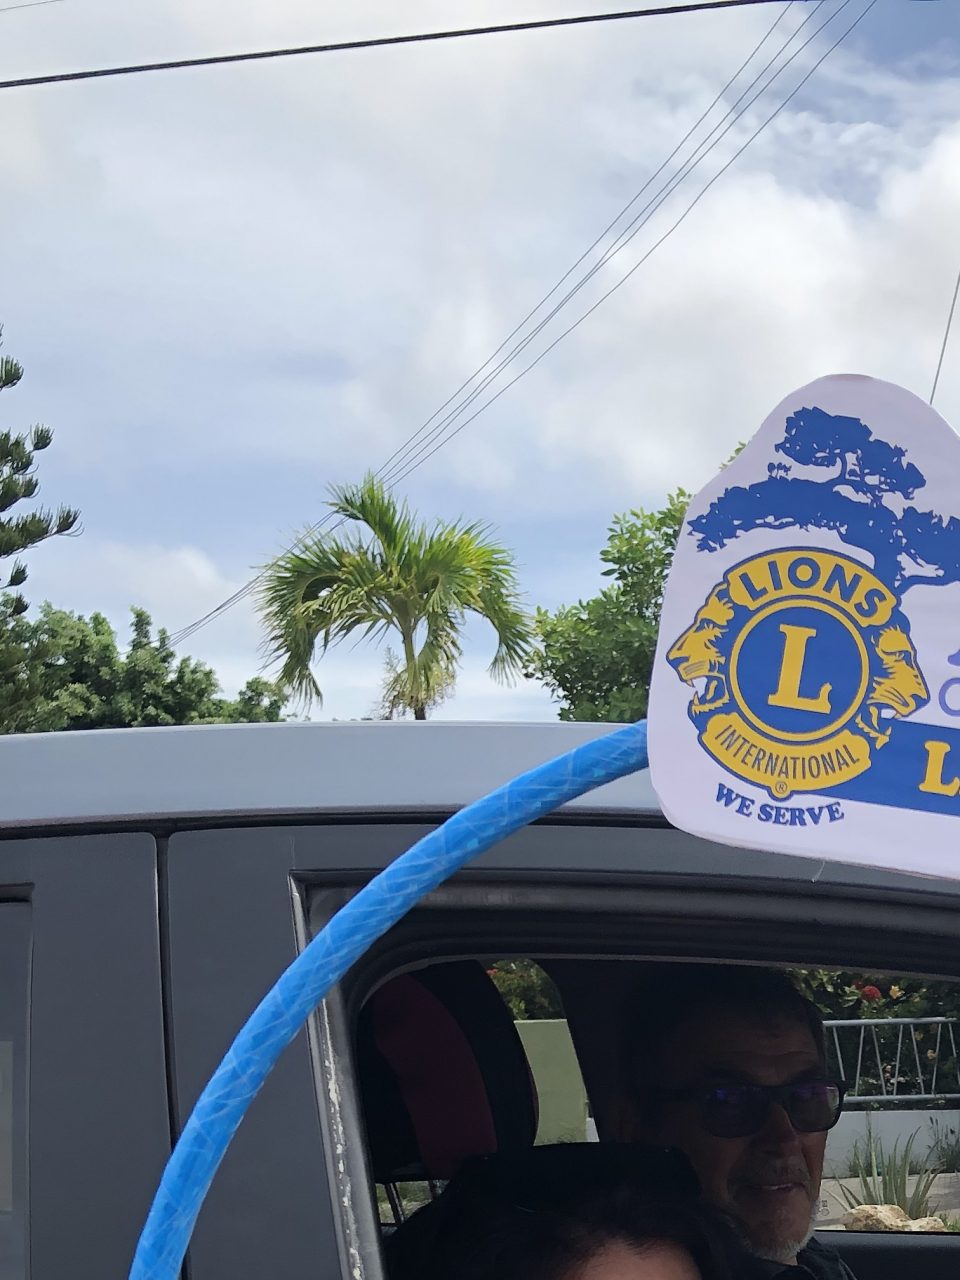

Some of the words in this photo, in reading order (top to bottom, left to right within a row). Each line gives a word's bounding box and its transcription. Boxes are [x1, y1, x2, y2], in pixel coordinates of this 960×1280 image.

[738, 556, 888, 618] LIONS
[767, 623, 833, 715] L
[714, 723, 861, 781] INTERNATIONAL
[715, 782, 755, 818] WE
[757, 801, 845, 827] SERVE
